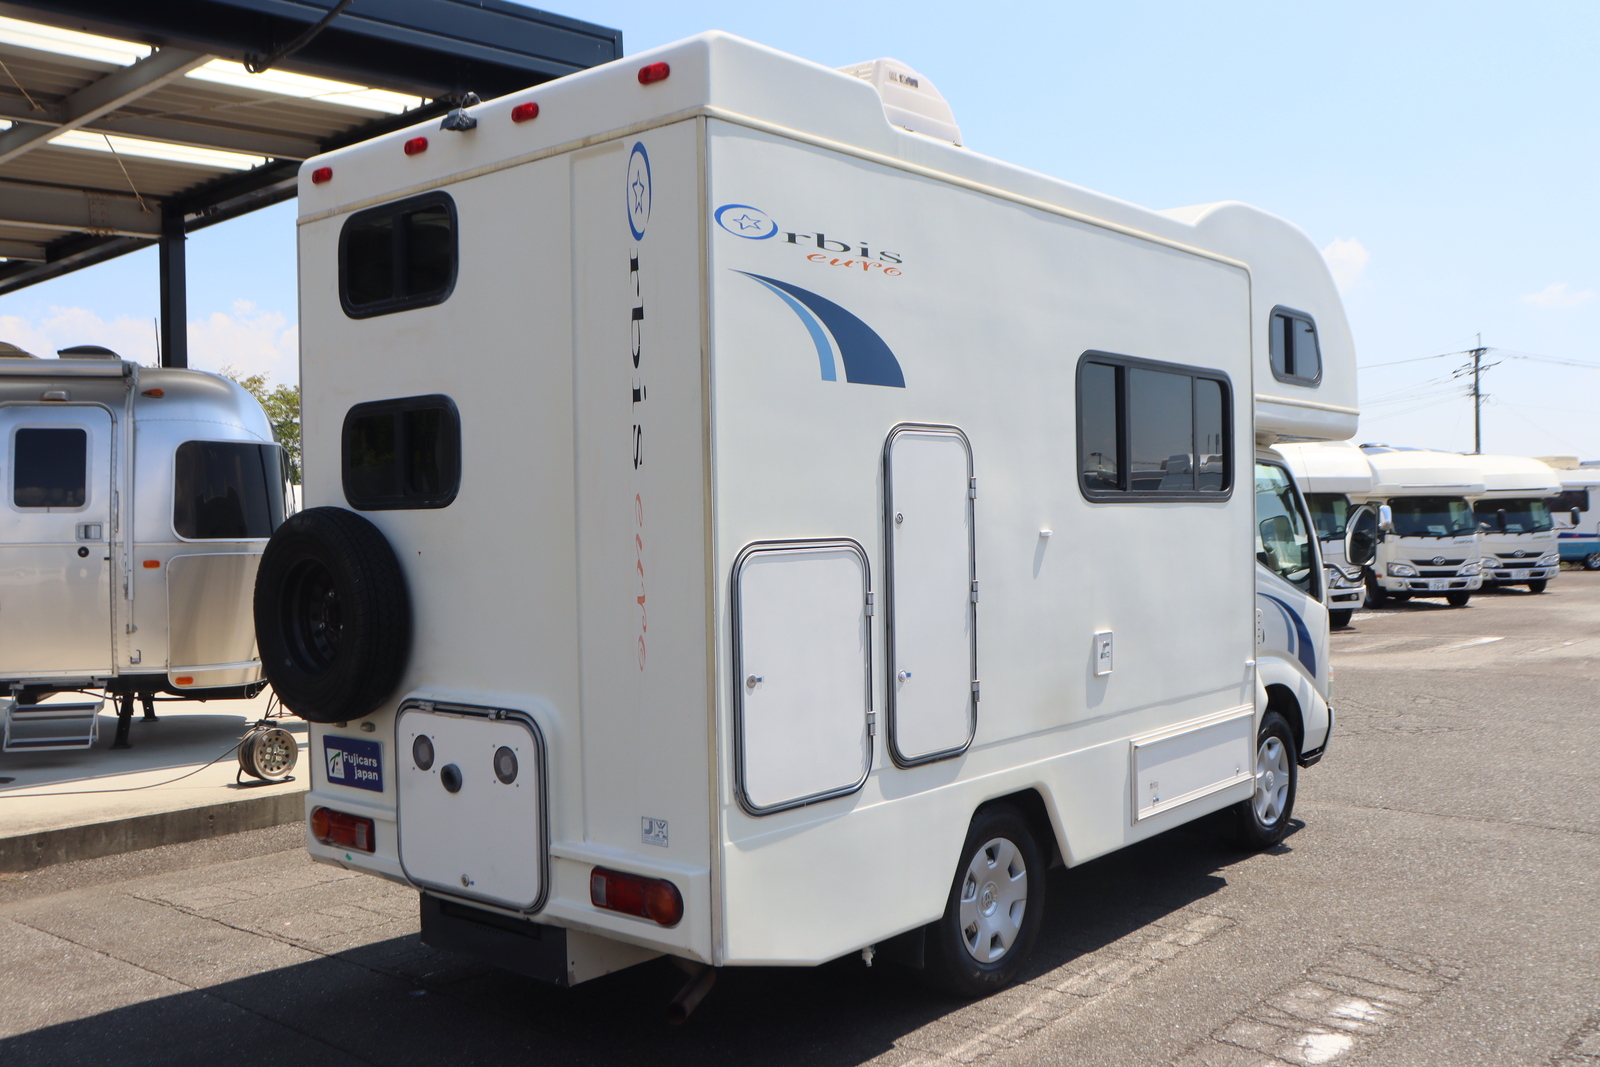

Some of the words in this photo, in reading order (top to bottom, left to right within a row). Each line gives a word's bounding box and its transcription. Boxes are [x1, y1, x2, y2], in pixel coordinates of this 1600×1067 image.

[806, 253, 903, 277] euro
[635, 493, 647, 672] euro
[343, 751, 378, 768] Fujicars
[354, 766, 379, 781] japan
